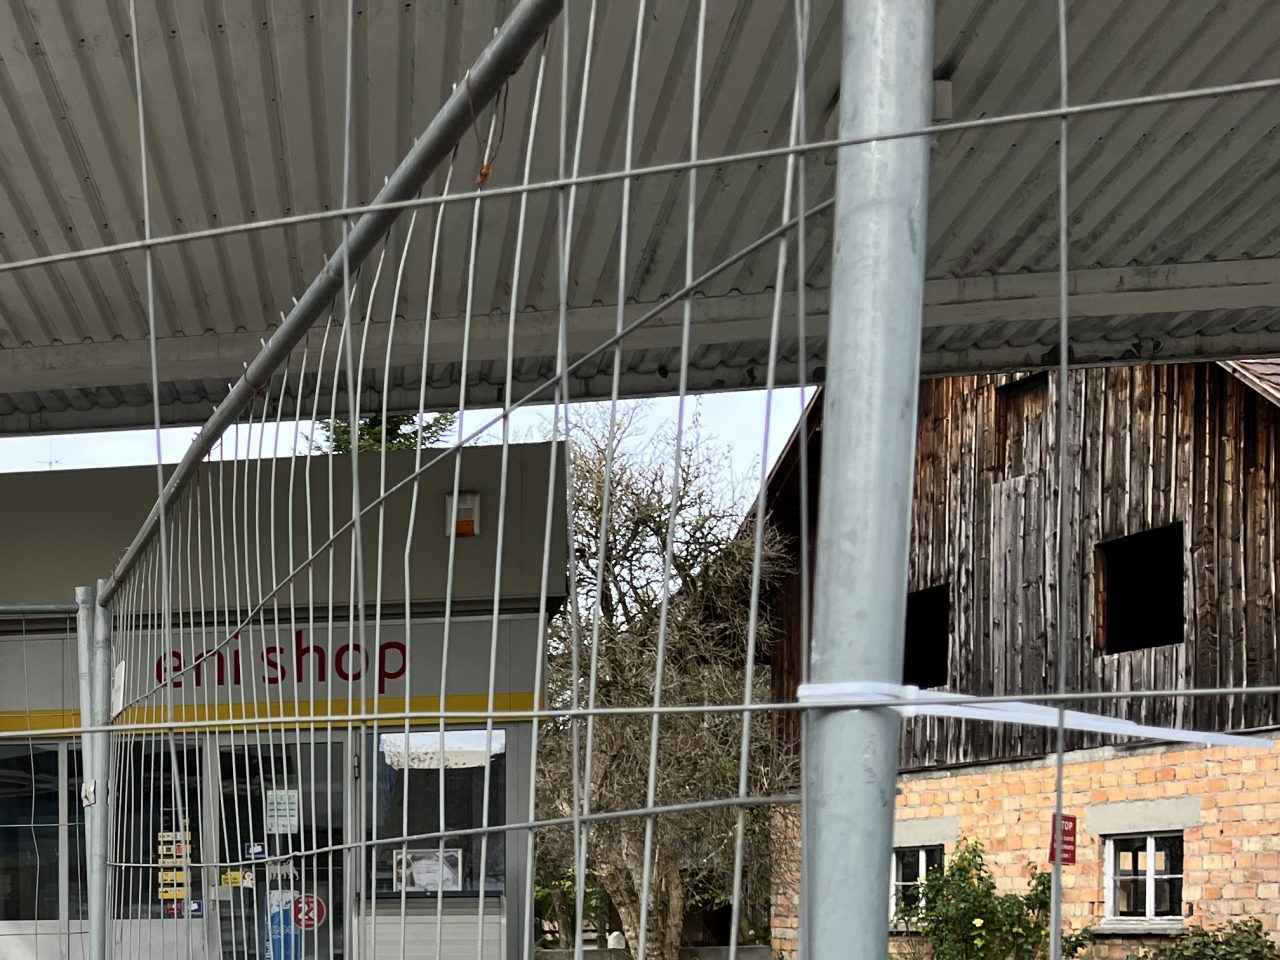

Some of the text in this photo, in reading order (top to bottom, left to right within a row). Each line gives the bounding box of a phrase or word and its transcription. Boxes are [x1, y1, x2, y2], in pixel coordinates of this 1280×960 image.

[155, 630, 408, 694] eni shop
[1056, 820, 1073, 831] TOP
